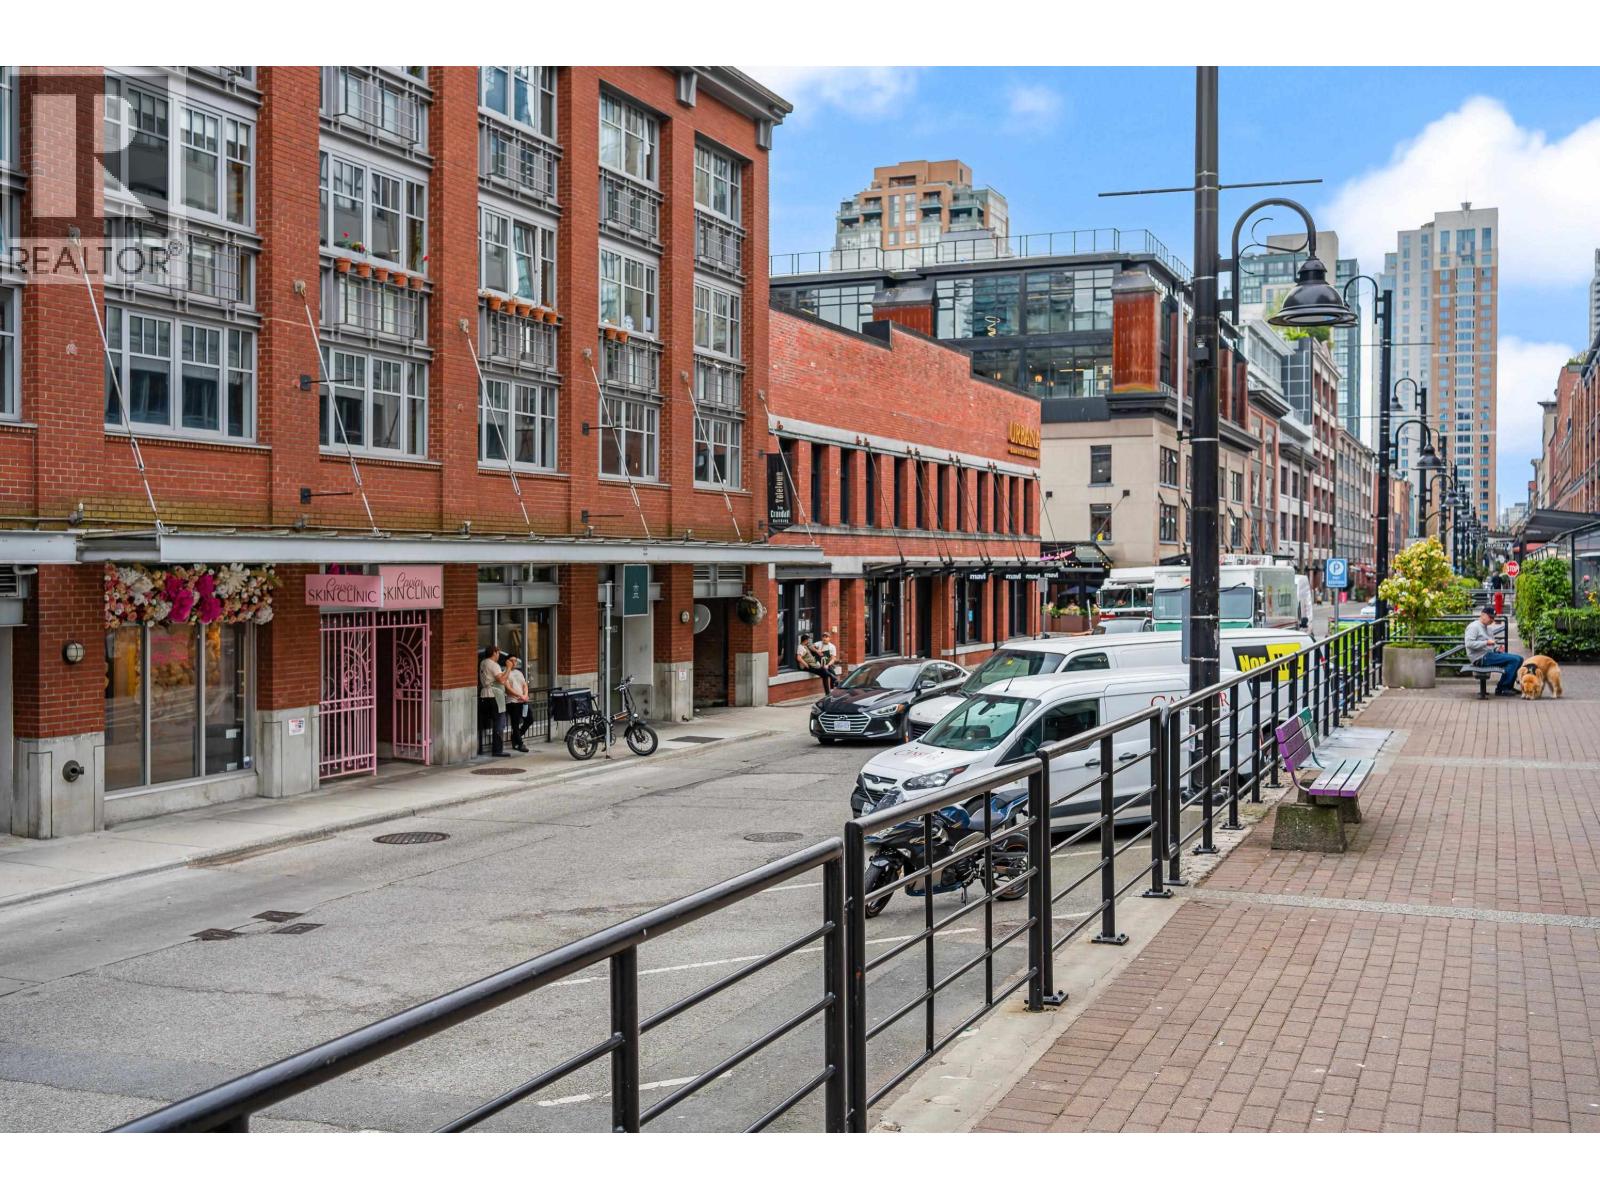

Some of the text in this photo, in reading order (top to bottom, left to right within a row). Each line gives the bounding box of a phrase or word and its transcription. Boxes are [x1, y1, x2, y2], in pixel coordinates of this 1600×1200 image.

[309, 587, 377, 603] SKIN CLINIC
[406, 581, 440, 600] CLINIC
